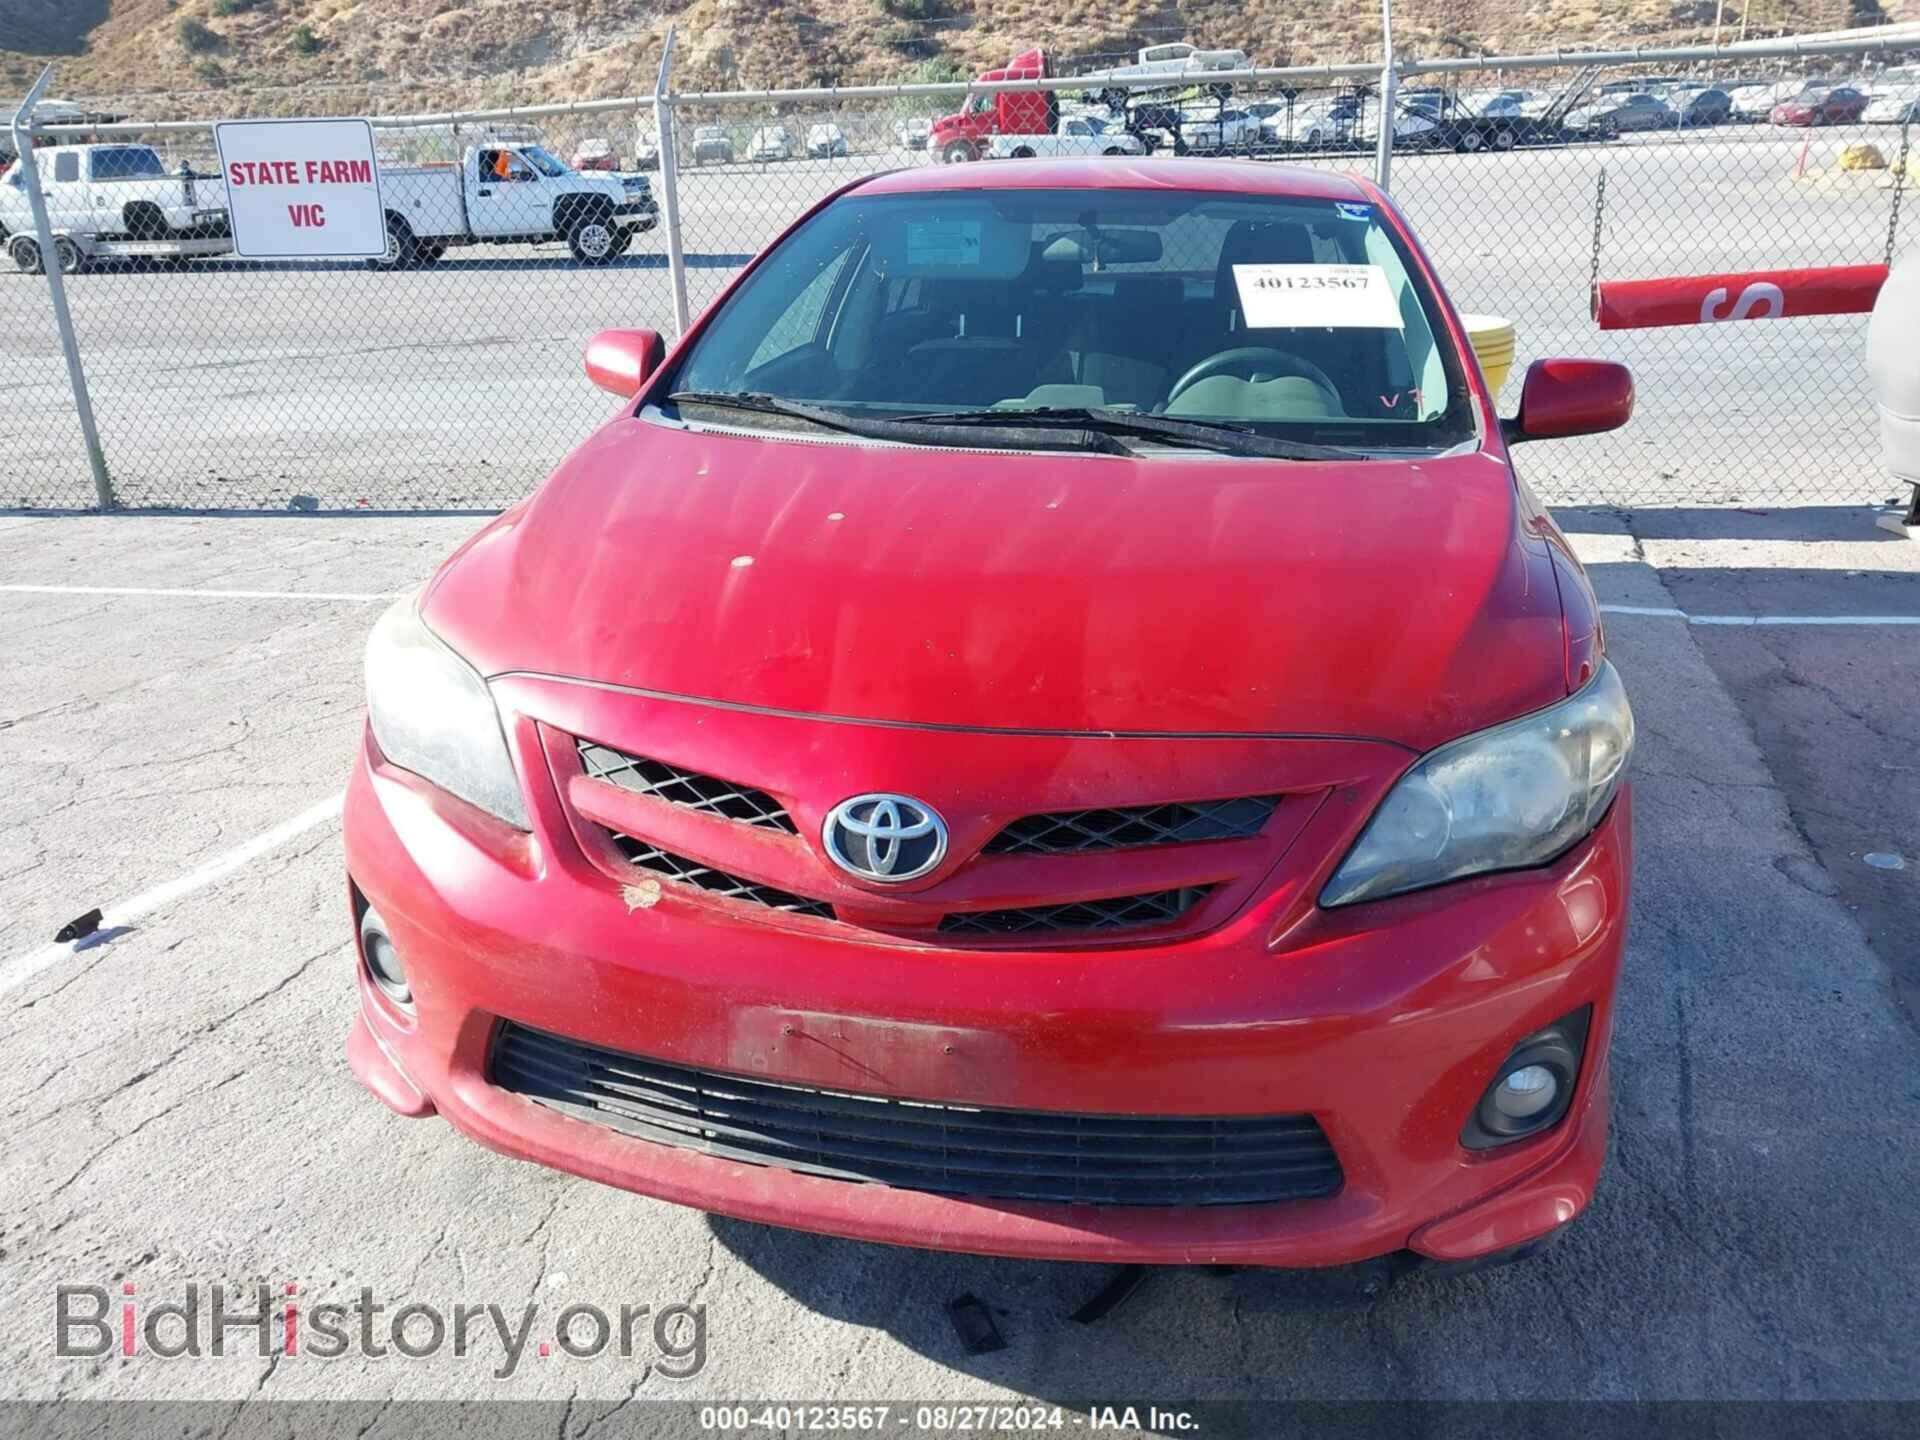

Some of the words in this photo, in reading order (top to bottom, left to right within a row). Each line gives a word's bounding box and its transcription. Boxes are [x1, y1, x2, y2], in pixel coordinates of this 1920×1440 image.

[230, 162, 299, 185] STATE
[305, 160, 372, 183] FARM
[288, 204, 325, 227] VIC
[1253, 276, 1369, 289] 40123567
